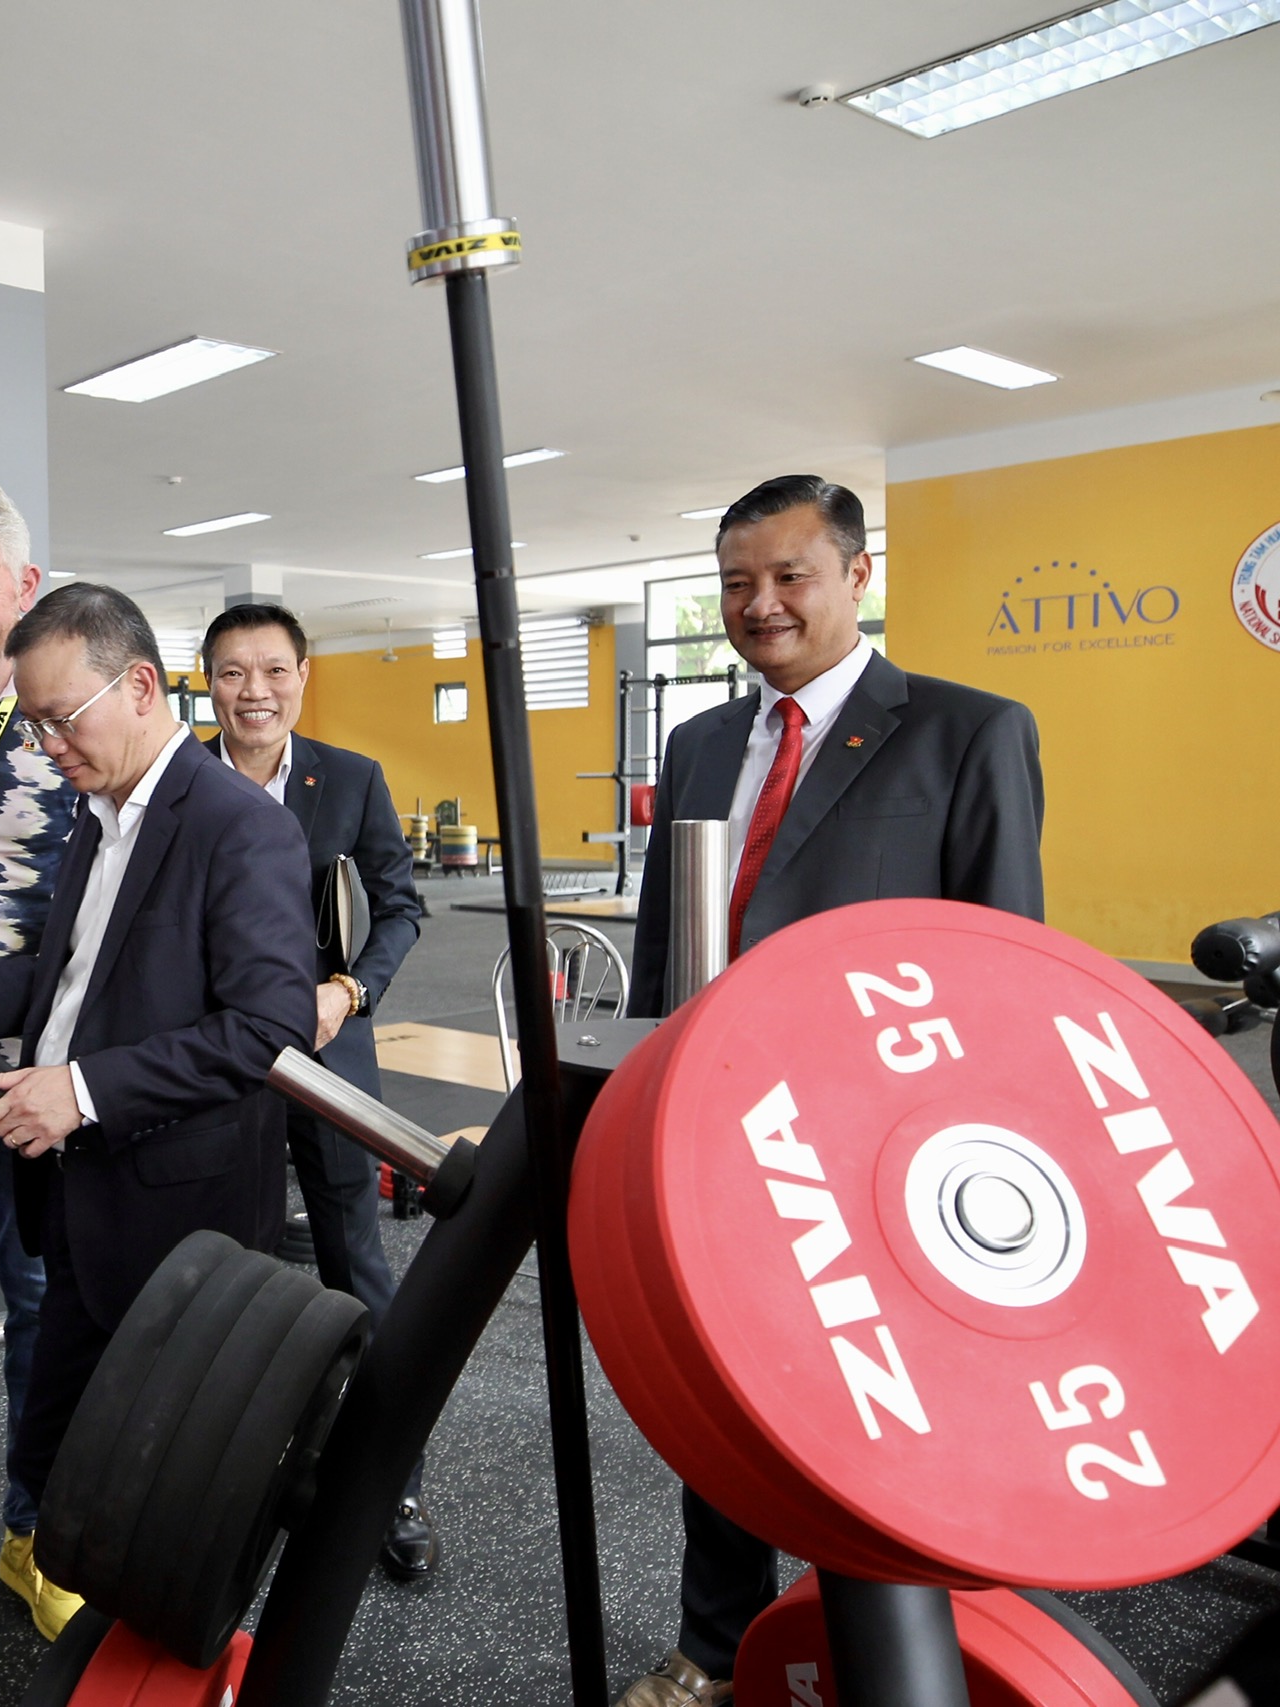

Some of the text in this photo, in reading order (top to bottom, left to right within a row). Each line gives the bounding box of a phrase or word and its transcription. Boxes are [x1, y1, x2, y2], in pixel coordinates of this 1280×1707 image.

[420, 238, 487, 261] ZIVA
[987, 633, 1175, 656] PASSION FOR EXCELLENCE
[988, 586, 1180, 637] ATTIVO
[845, 962, 964, 1074] 25
[1052, 1012, 1259, 1354] ZIVA
[741, 1080, 931, 1440] ZIVA
[1028, 1364, 1166, 1500] 25
